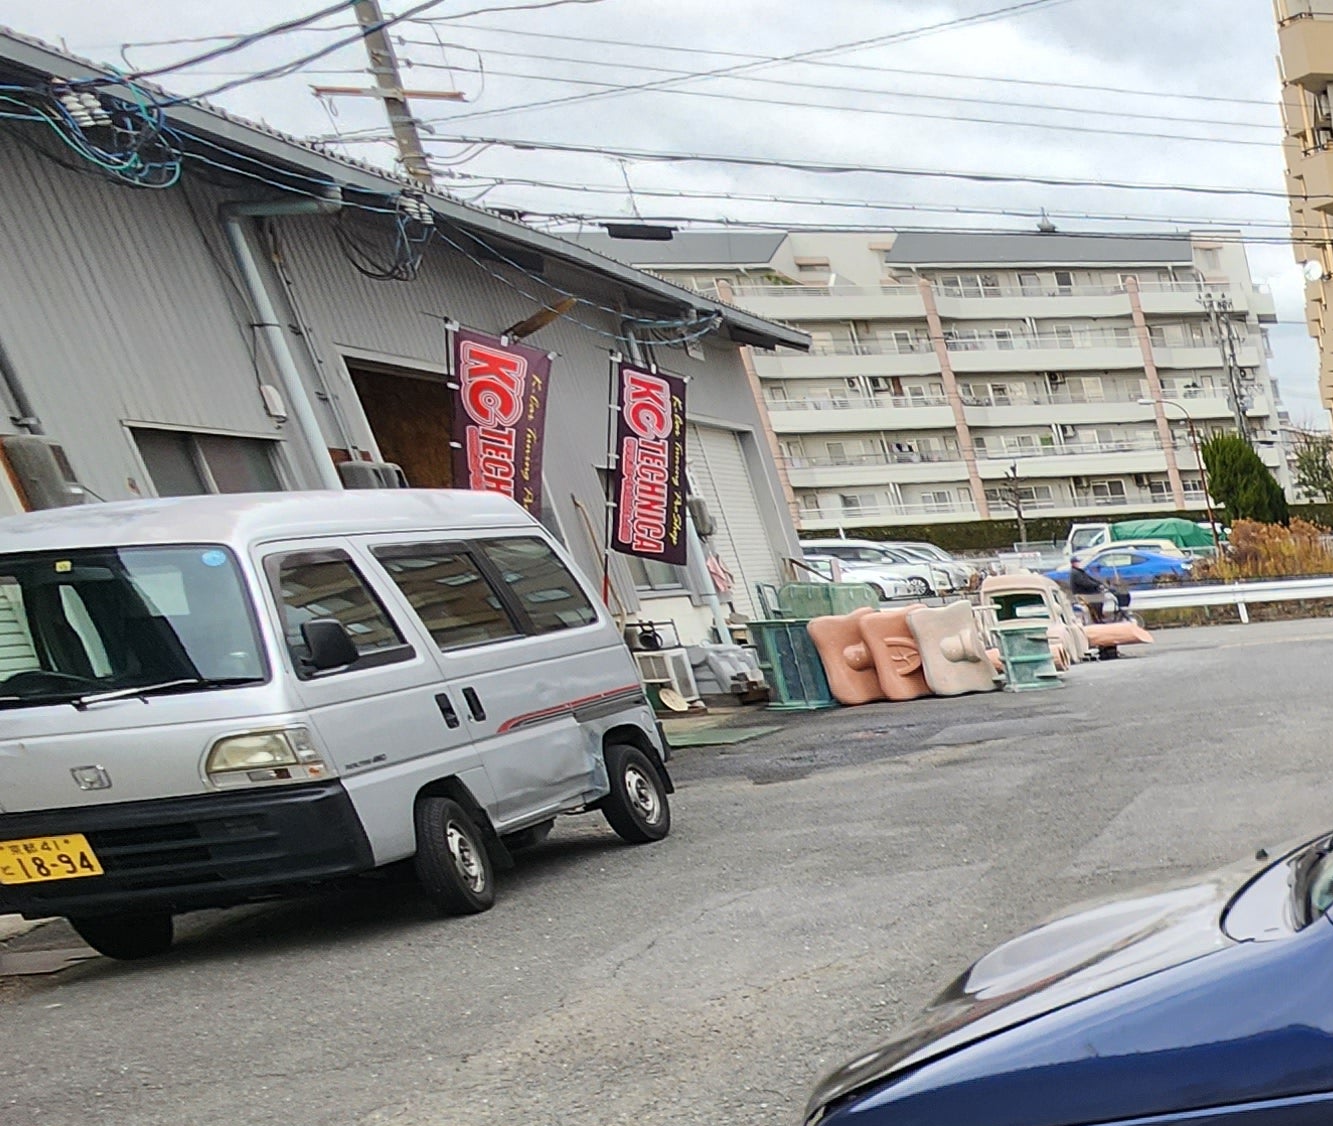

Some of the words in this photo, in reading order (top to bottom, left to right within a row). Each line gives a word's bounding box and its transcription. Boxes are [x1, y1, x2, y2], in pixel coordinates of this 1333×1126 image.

[462, 342, 527, 426] KC
[624, 370, 672, 438] KC
[632, 438, 668, 553] TECHNICA
[16, 850, 95, 879] 18-94
